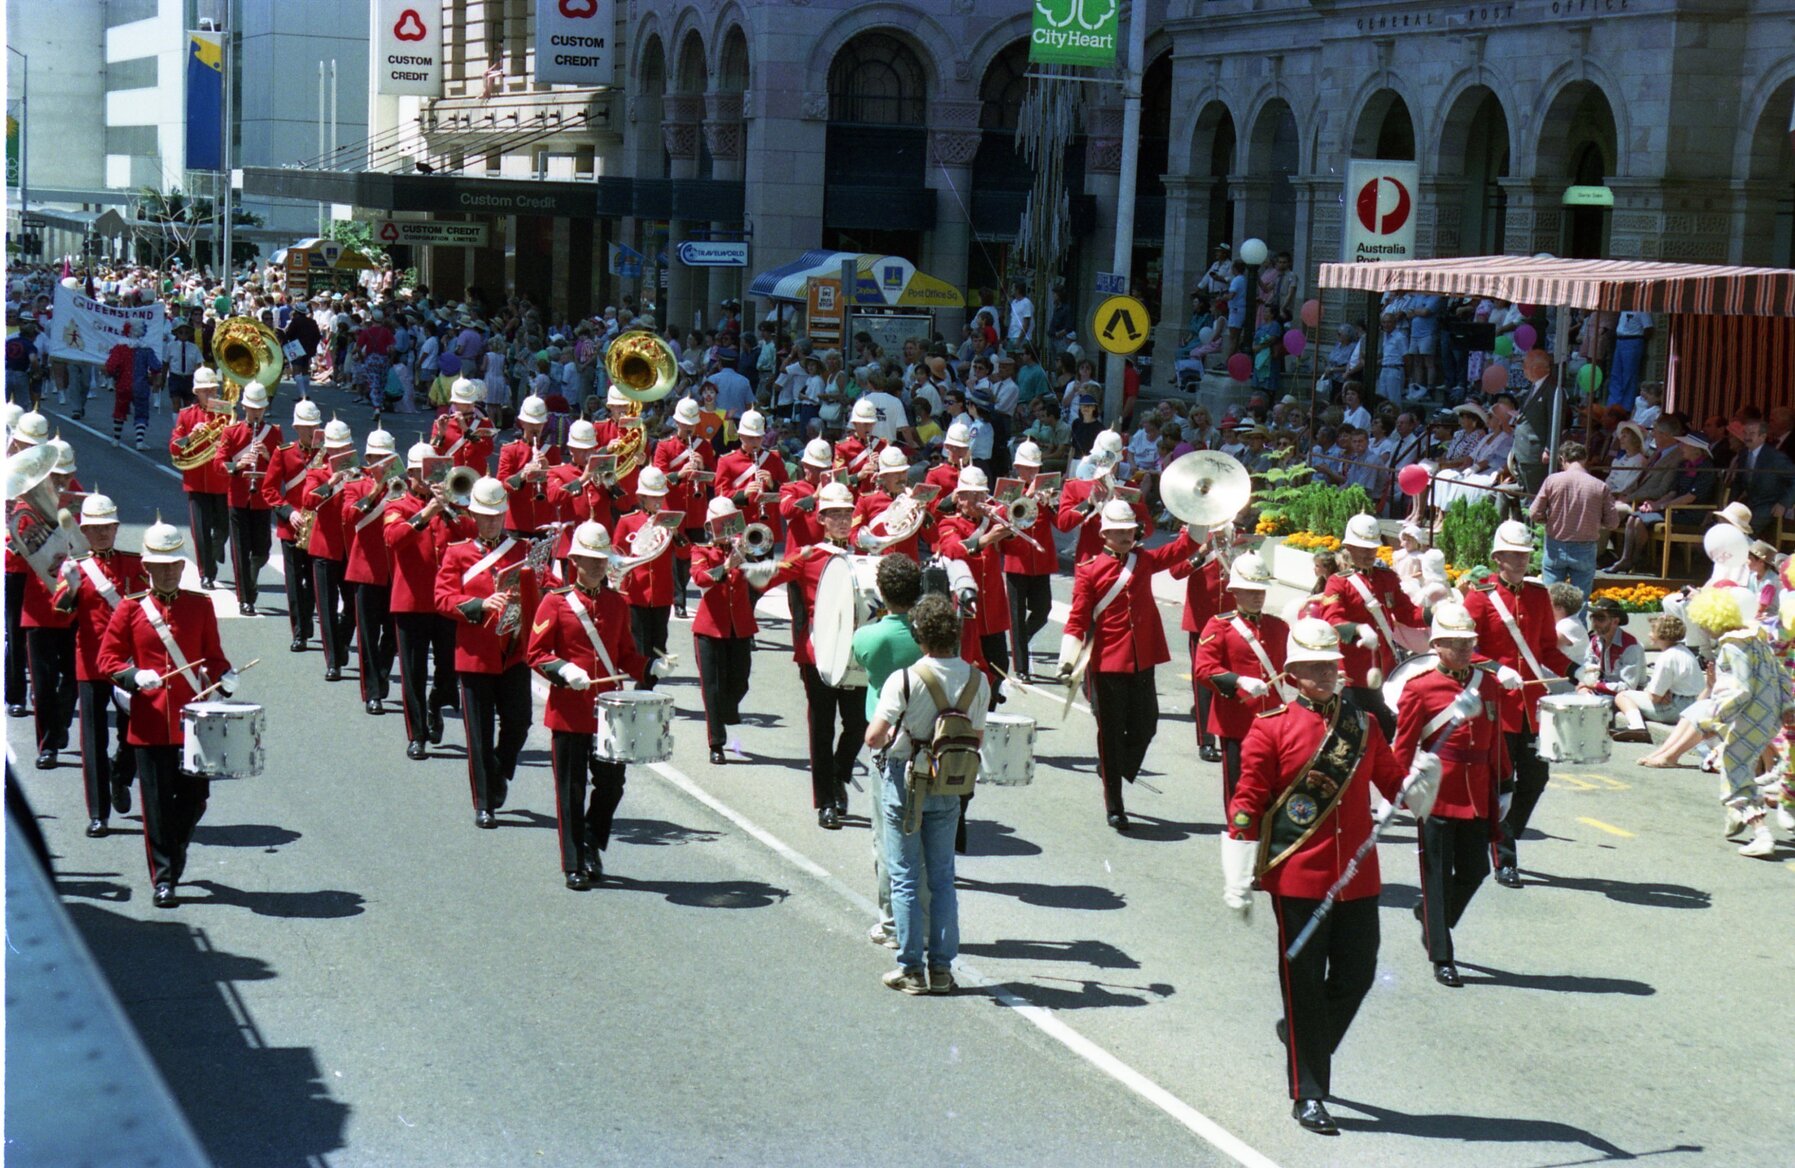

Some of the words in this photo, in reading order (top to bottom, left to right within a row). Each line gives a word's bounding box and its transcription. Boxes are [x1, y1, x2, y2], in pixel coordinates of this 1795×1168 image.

[1357, 12, 1433, 30] GENERAL
[1468, 5, 1513, 22] POST
[1552, 0, 1628, 14] OFFICE
[551, 35, 605, 49] CUSTOM
[388, 55, 432, 66] CUSTOM
[555, 54, 600, 68] CREDIT
[391, 71, 429, 82] CREDIT
[460, 193, 513, 207] Custom
[516, 195, 556, 209] Credit
[402, 225, 442, 234] CUSTOM
[446, 227, 480, 236] CREDIT
[1356, 242, 1406, 255] Australia
[908, 288, 924, 298] Post
[925, 288, 945, 299] Office
[946, 290, 958, 300] Sq
[73, 297, 154, 320] QUEENSLAND
